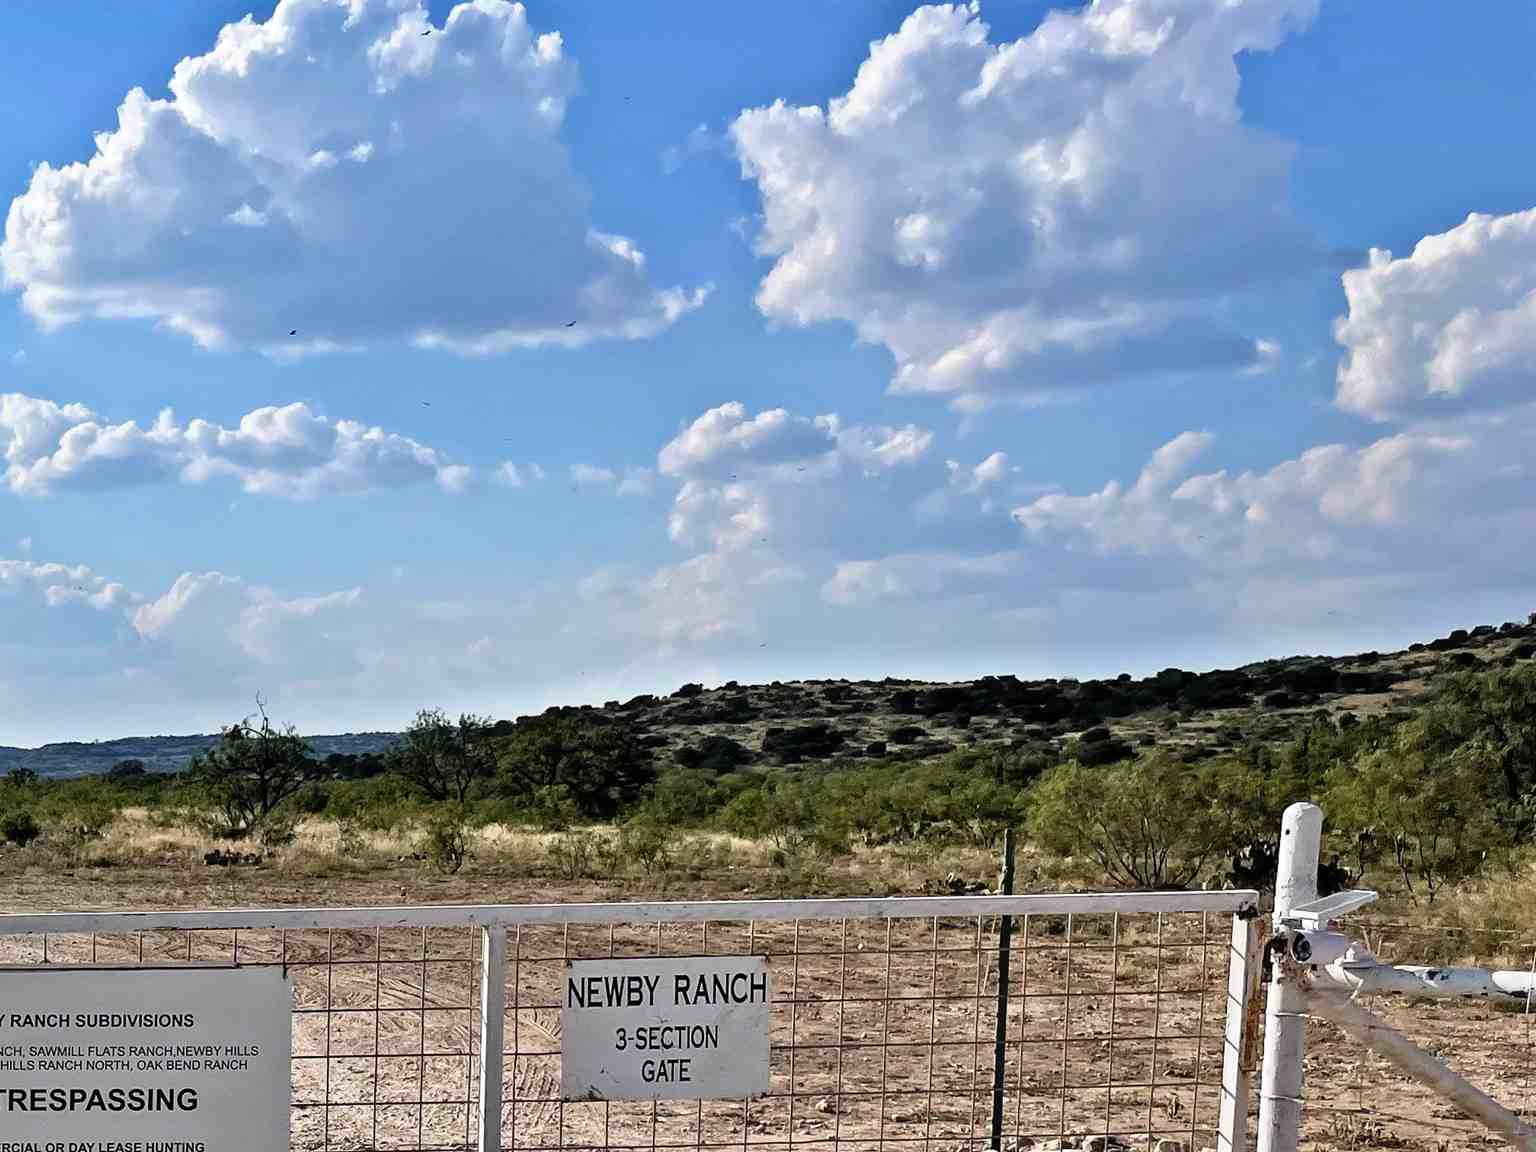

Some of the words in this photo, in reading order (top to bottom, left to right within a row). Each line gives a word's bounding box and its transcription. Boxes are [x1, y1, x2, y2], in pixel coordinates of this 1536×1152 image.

[567, 975, 661, 1008] NEWBY
[674, 971, 767, 1005] RANCH
[10, 1014, 70, 1028] RANCH
[75, 1014, 194, 1028] SUBDIVISIONS
[615, 1024, 719, 1050] 3-SECTION
[29, 1046, 84, 1057] SAWMILL
[88, 1046, 126, 1057] FLATS
[225, 1046, 259, 1057] HILLS
[0, 1060, 35, 1071] HILLS
[38, 1060, 82, 1071] RANCH
[86, 1060, 133, 1072] NORTH,
[137, 1060, 163, 1071] OAK
[166, 1060, 201, 1071] BEND
[204, 1060, 248, 1071] RANCH
[641, 1058, 691, 1083] GATE
[68, 1143, 95, 1152] DAY
[98, 1143, 142, 1152] LEASE
[146, 1142, 205, 1152] HUNTING
